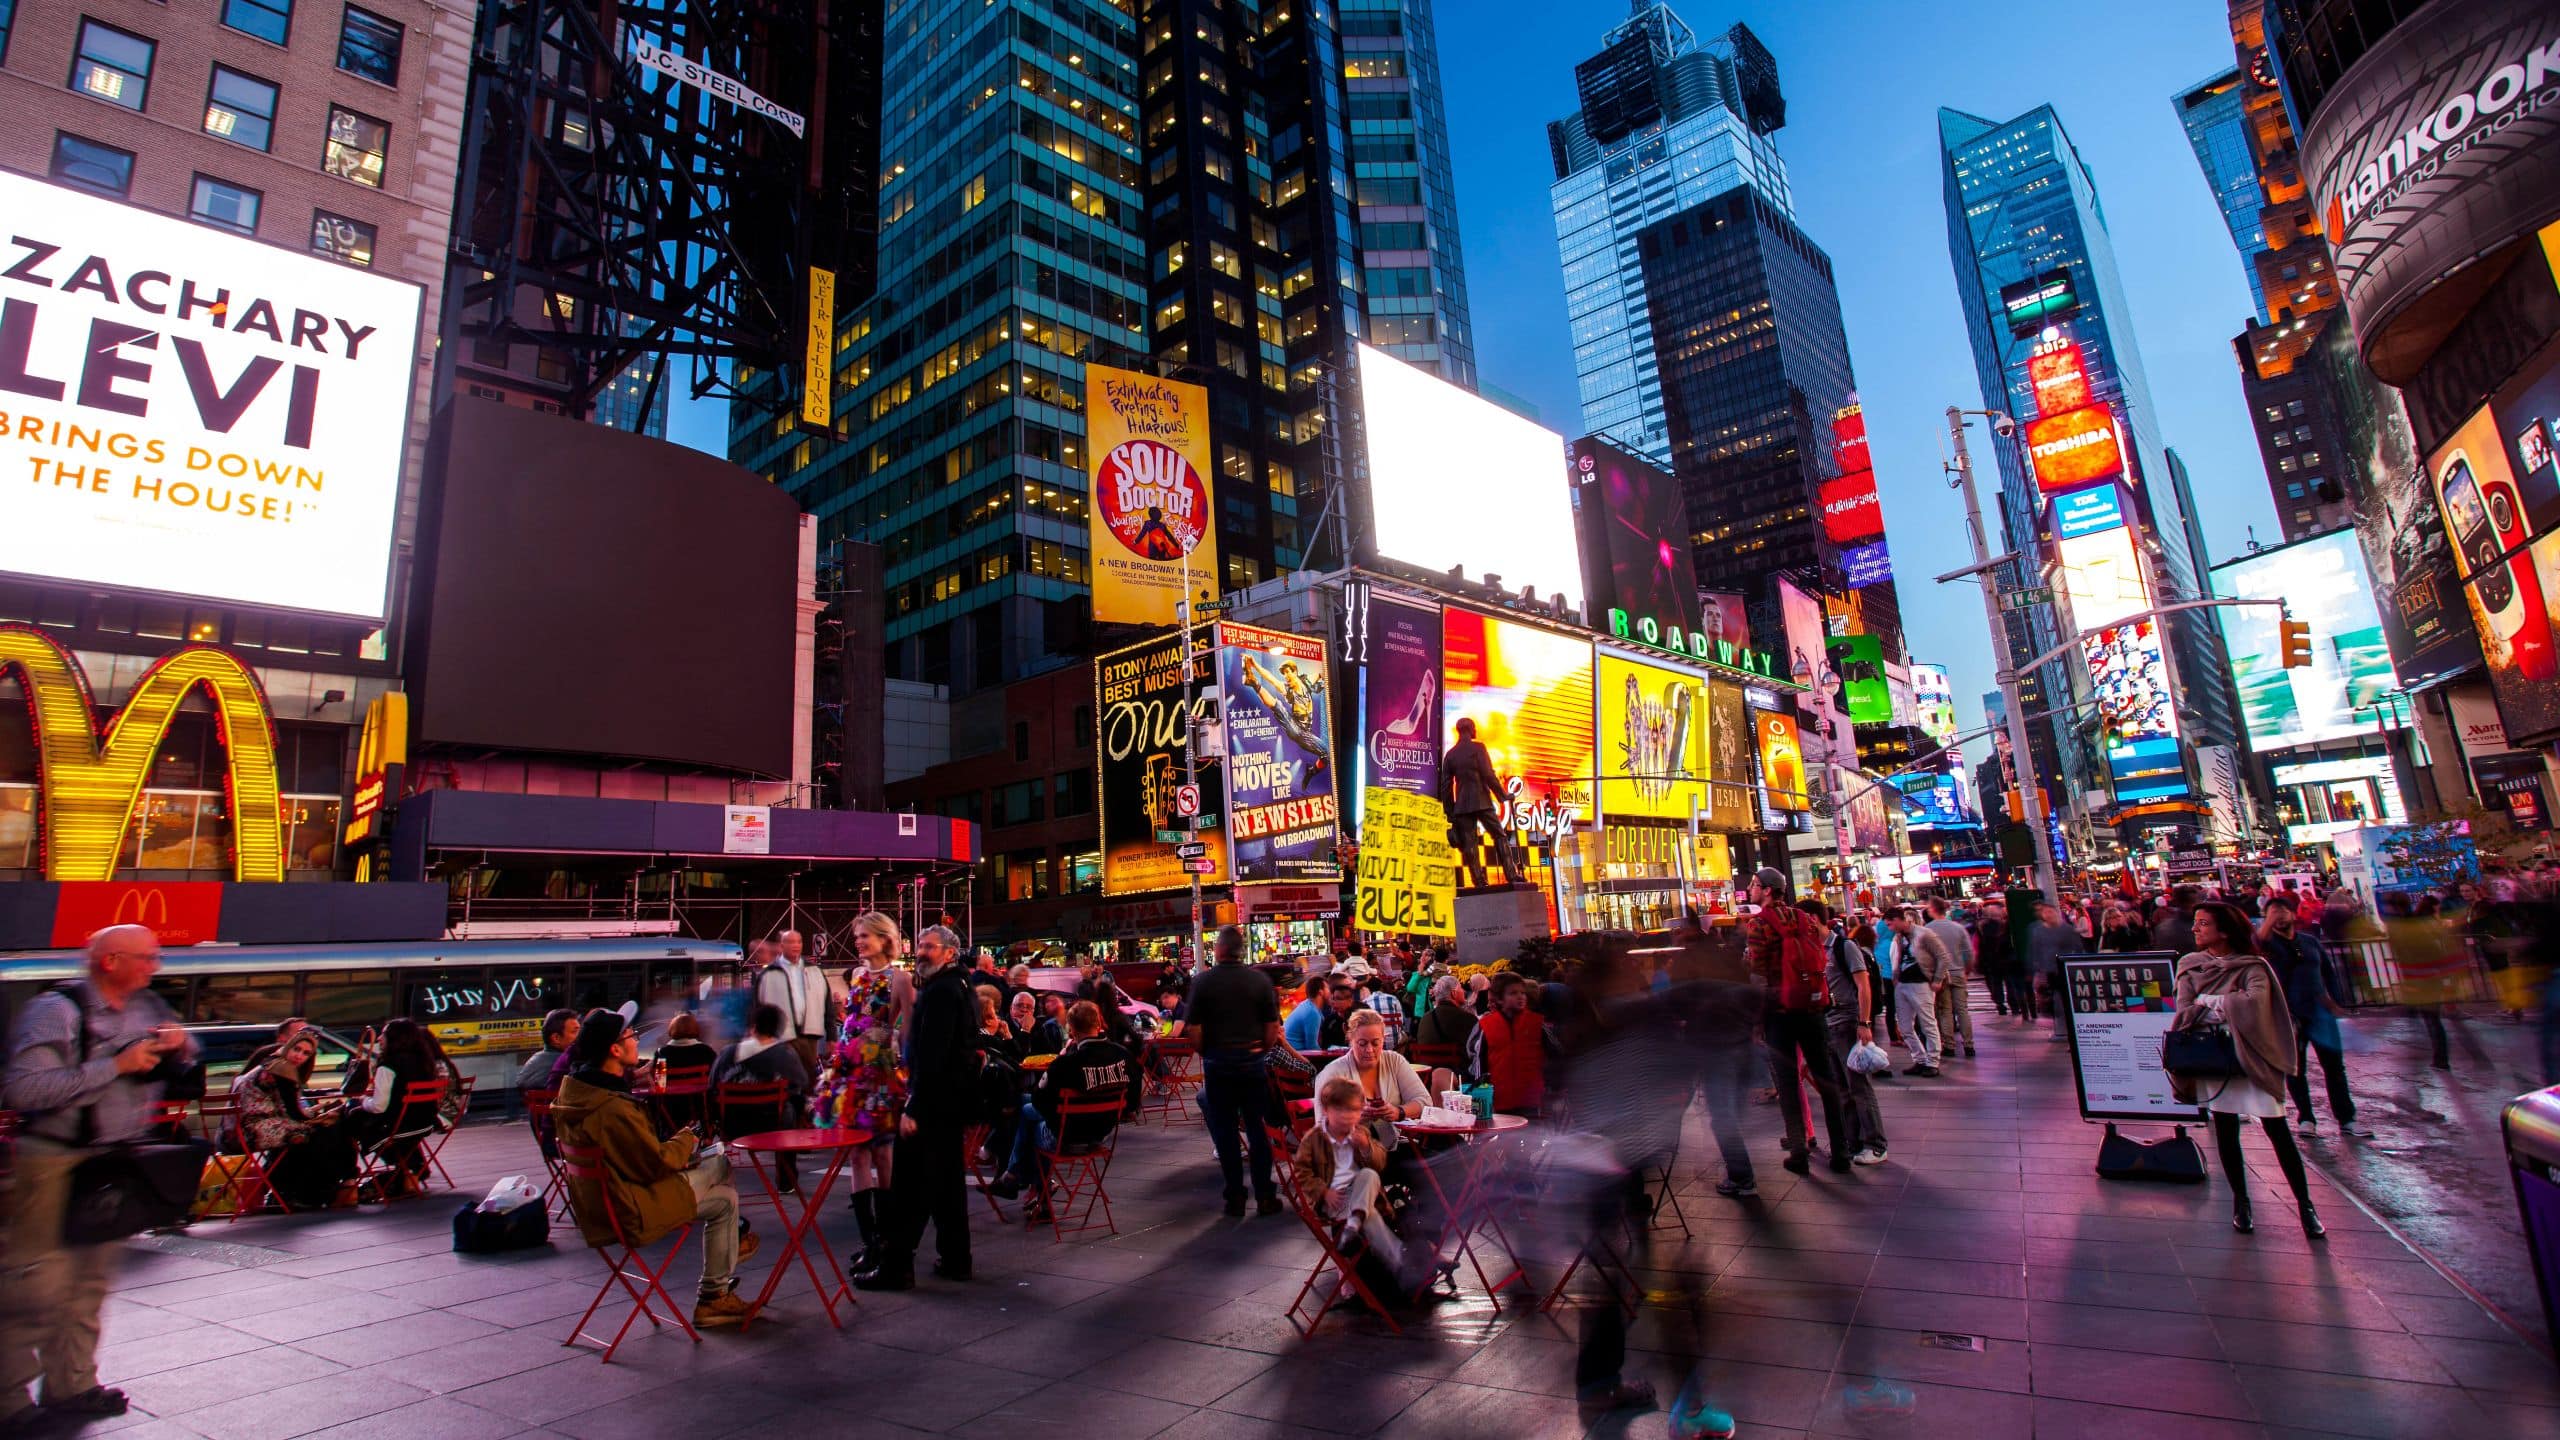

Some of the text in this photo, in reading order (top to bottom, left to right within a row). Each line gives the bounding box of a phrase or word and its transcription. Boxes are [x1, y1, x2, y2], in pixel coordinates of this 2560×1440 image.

[640, 46, 802, 132] J.C. STEEL CORP.
[2369, 85, 2560, 220] driving emotio
[1, 235, 377, 360] ZACHARY
[815, 271, 831, 322] WEIR
[2033, 339, 2069, 357] 2013
[0, 297, 320, 450] LEVI
[812, 324, 829, 419] WELDING
[2036, 370, 2082, 389] TOSHIBA
[0, 411, 324, 491] BRINGS DOWN
[2031, 427, 2113, 459] TOSHIBA
[29, 456, 112, 493] THE
[1111, 443, 1193, 492] SOUL
[1581, 471, 1596, 485] LG
[1117, 485, 1194, 518] DOCTOR
[1108, 559, 1128, 569] NEW
[1130, 561, 1175, 576] BROADWAY
[2015, 593, 2024, 606] W
[2027, 591, 2040, 604] 46
[1222, 627, 1237, 637] BEST
[1239, 629, 1258, 642] SCORE
[1608, 607, 1773, 677] ROADWAY
[1104, 666, 1113, 683] 8
[1113, 655, 1149, 680] TONY
[1105, 678, 1141, 703] BEST
[2467, 724, 2501, 736] Marr
[1231, 751, 1272, 768] NOTHING
[1232, 761, 1293, 793] MOVES
[1907, 779, 1934, 792] Broadway
[1272, 785, 1292, 800] LIKE
[2138, 796, 2169, 804] SONY
[1231, 794, 1336, 839] NEWSIES
[1158, 831, 1176, 842] TIMES
[1273, 825, 1334, 849] ON BROADWAY
[1606, 825, 1677, 863] FOREVER
[2179, 859, 2211, 868] HOT DOGS
[151, 930, 190, 939] OURS
[2075, 967, 2153, 982] AMEND
[2075, 983, 2137, 997] MENT
[2080, 998, 2125, 1012] ONE
[479, 1020, 536, 1031] JOHNNY'S
